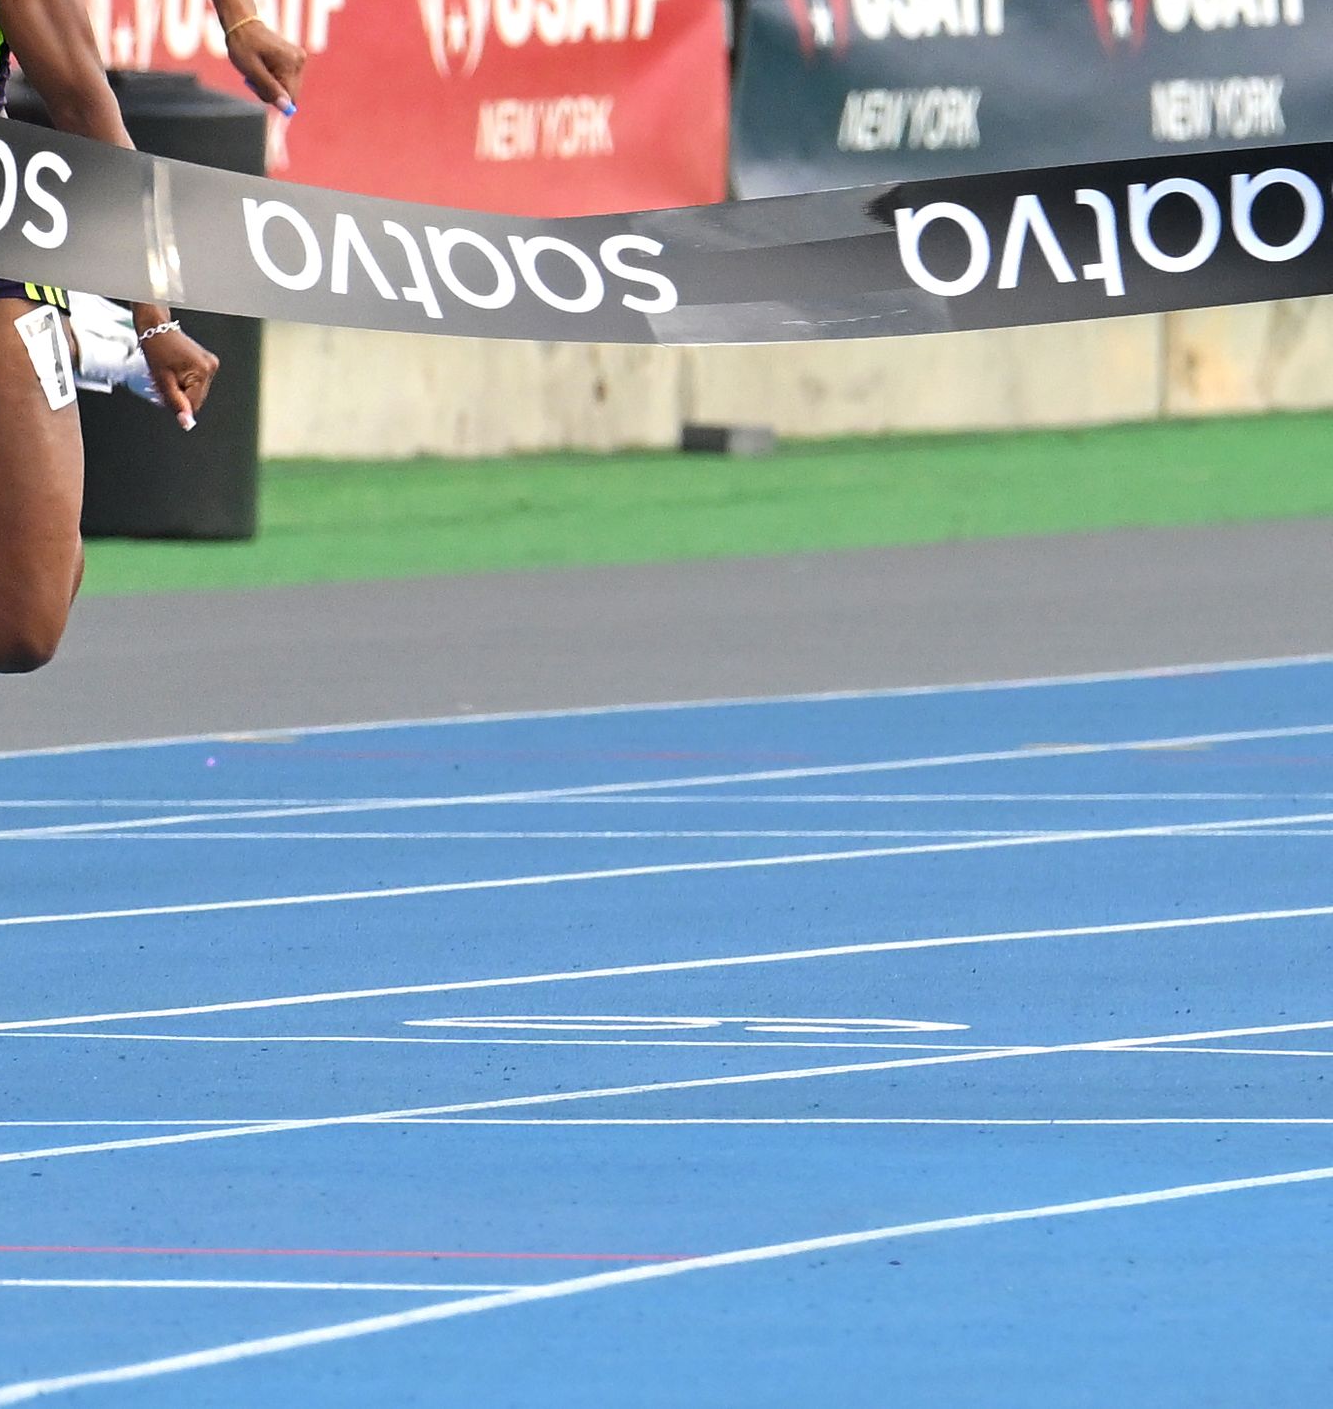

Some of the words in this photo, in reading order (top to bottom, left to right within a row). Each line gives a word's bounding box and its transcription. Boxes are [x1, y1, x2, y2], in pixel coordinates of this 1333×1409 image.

[474, 99, 537, 161] NEW
[538, 94, 615, 160] YORK
[836, 89, 904, 152] NEW
[906, 87, 983, 151] YORK
[1149, 80, 1213, 142] NEW
[1214, 75, 1288, 140] YORK
[242, 196, 679, 319] saatva
[894, 166, 1333, 298] aatva
